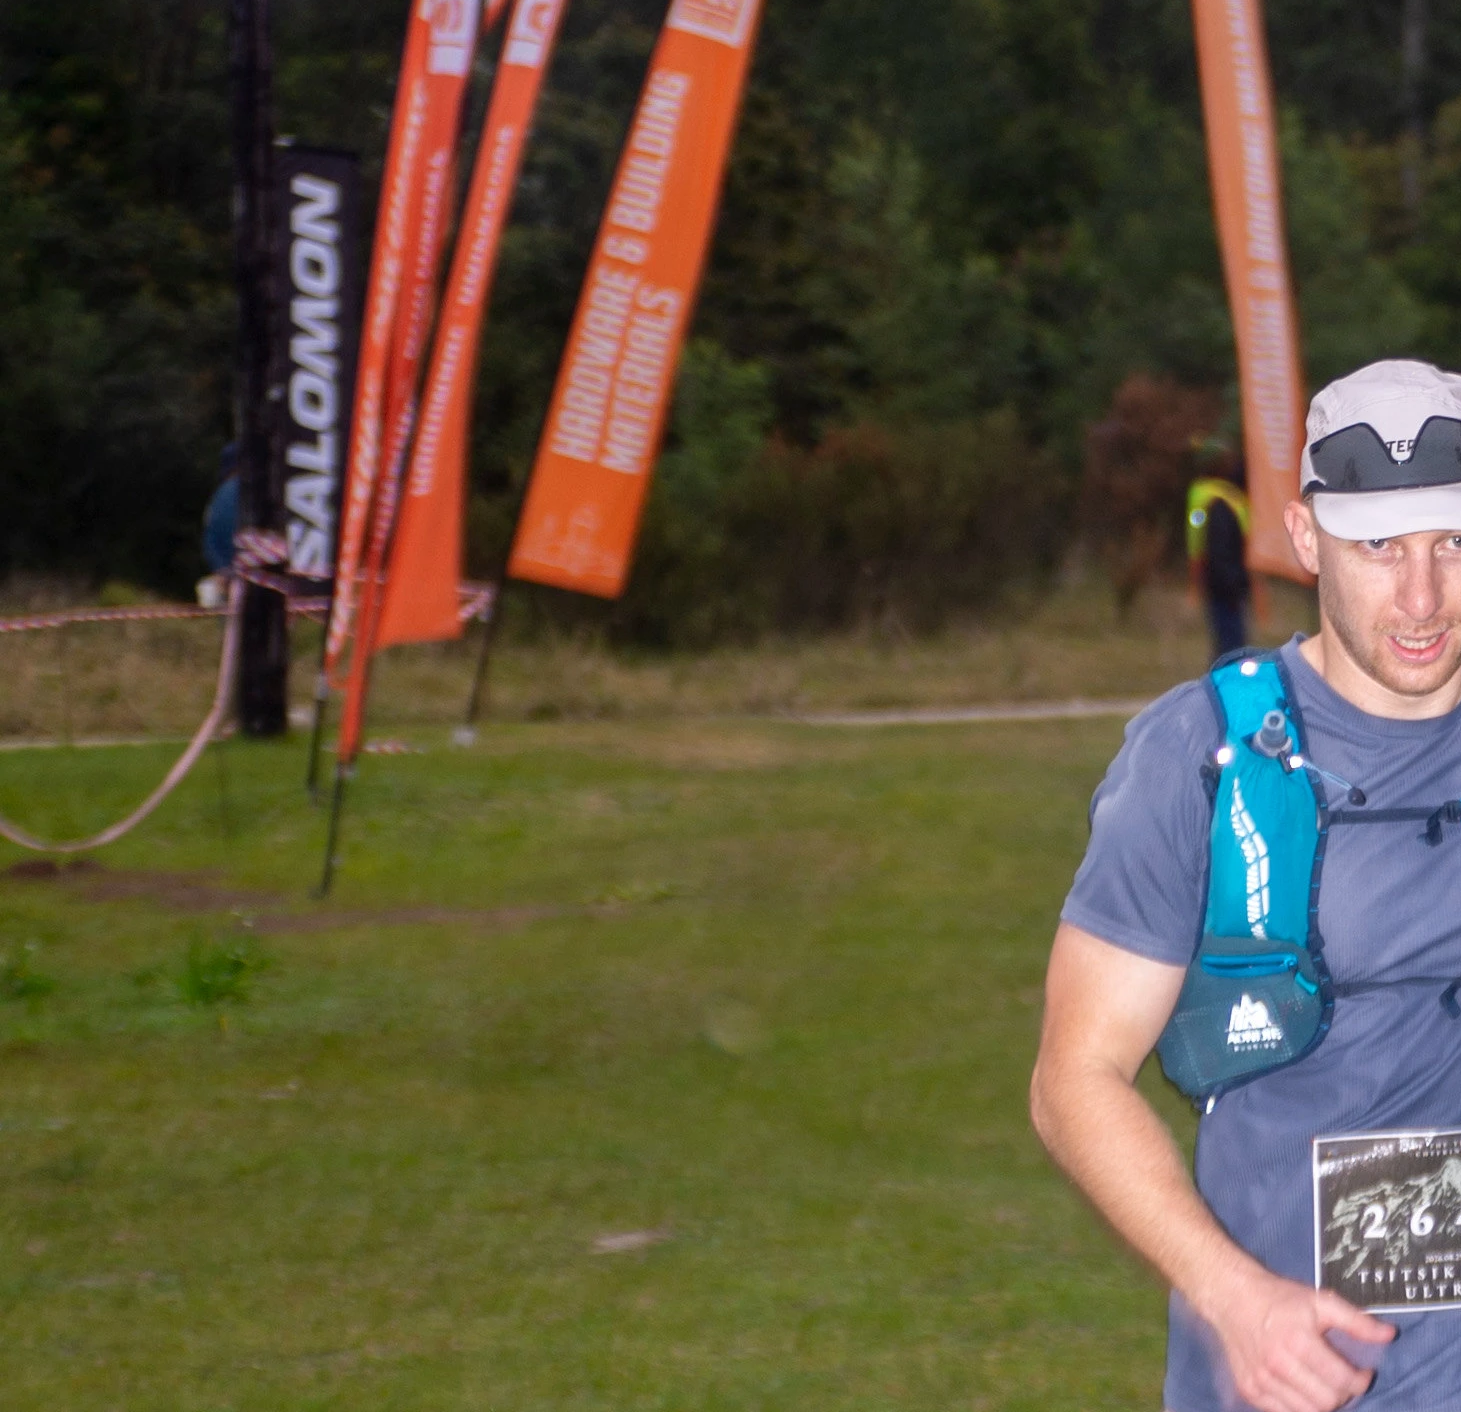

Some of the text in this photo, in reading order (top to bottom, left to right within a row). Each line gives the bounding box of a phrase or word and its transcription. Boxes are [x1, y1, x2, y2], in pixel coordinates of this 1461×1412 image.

[285, 173, 340, 578] SALOMON
[549, 266, 640, 462] HARDWARE
[610, 66, 691, 232] BUILDING
[600, 284, 682, 472] MATERIALS
